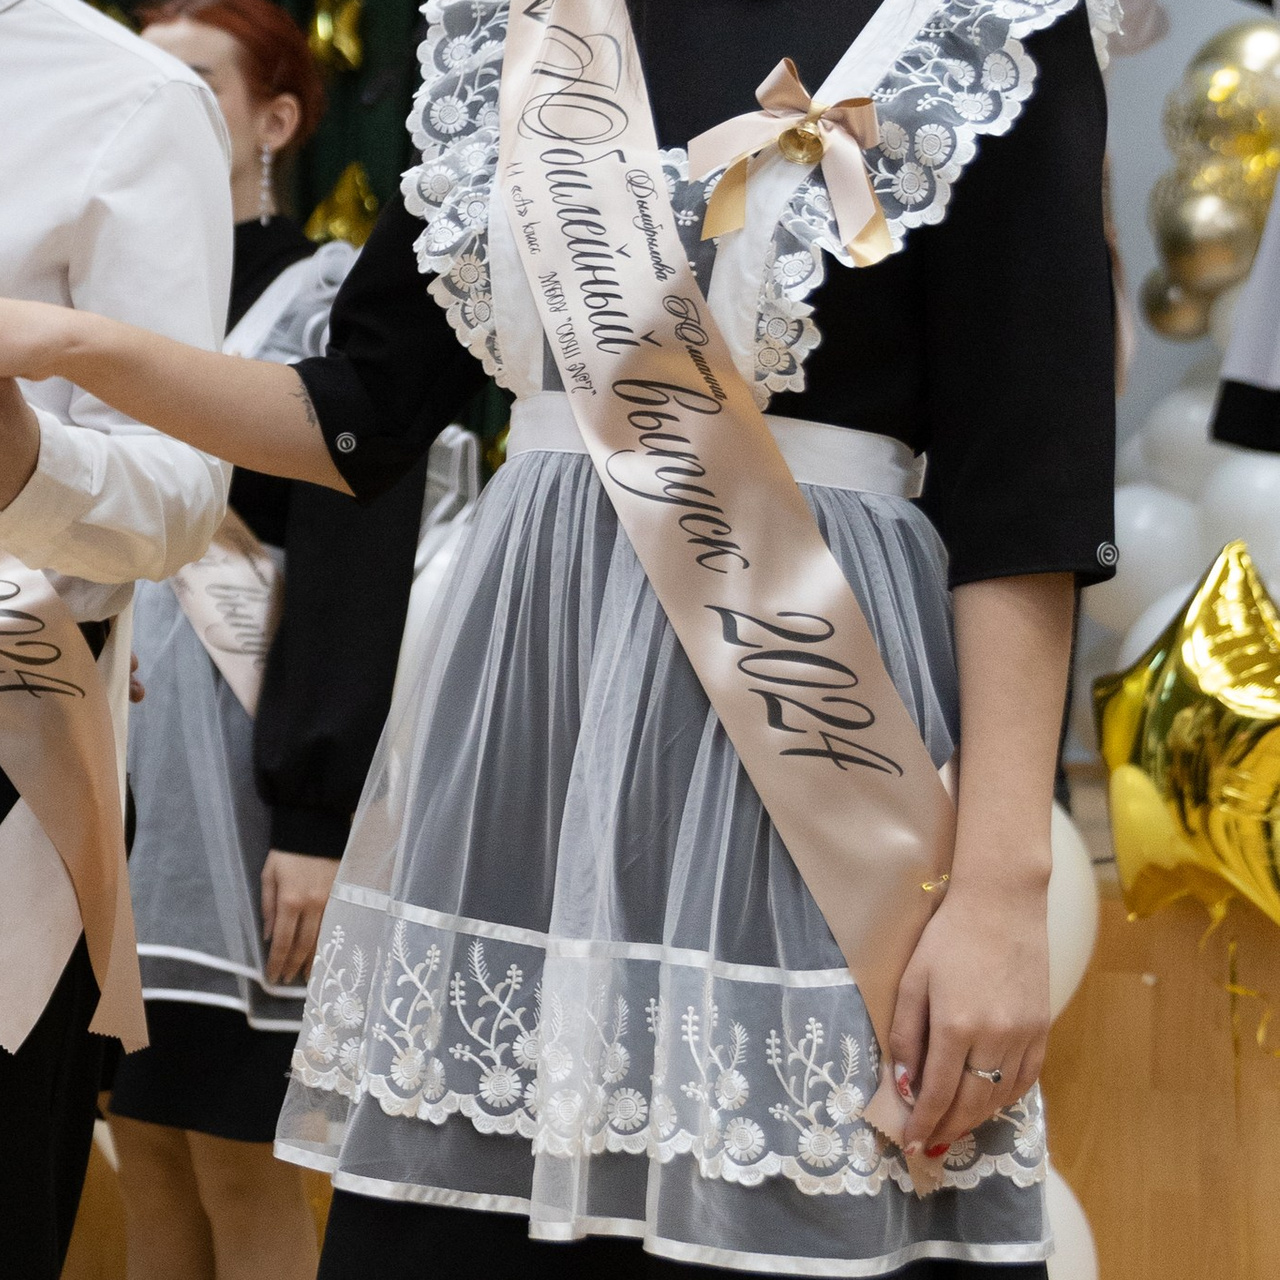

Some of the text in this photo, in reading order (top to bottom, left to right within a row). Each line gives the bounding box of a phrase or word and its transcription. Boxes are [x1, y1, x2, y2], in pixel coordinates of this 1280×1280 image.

[517, 25, 904, 777] Юбилейный выпуск 2024
[522, 221, 542, 256] класс
